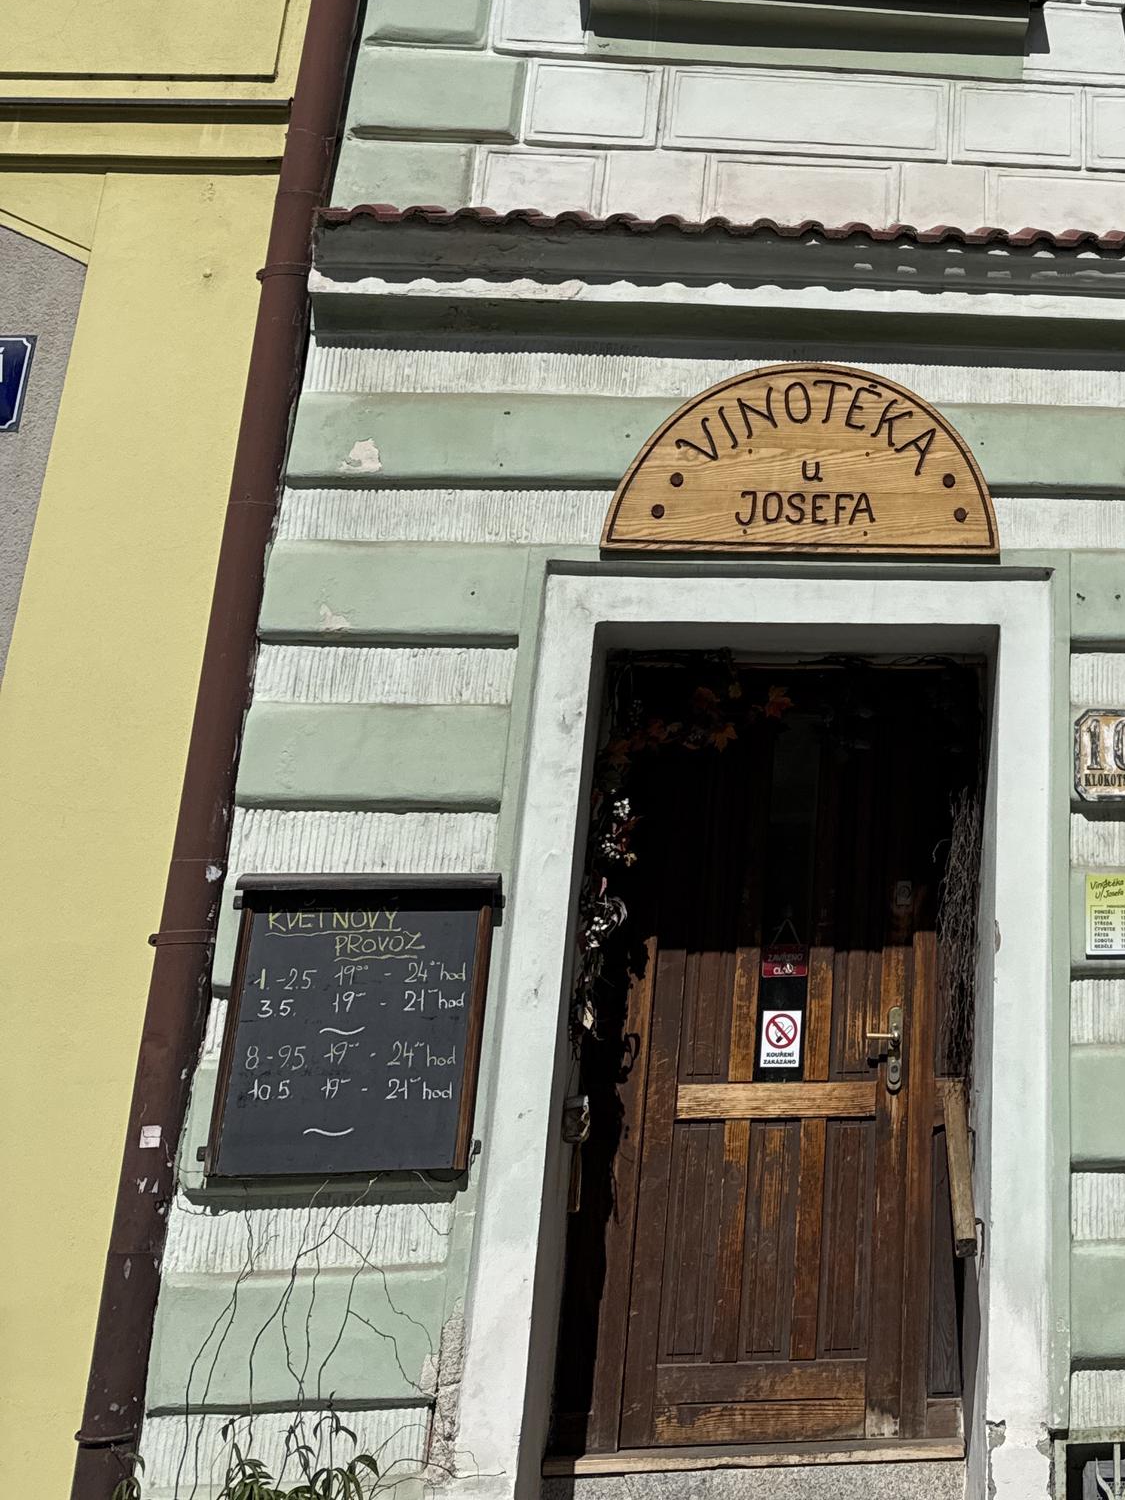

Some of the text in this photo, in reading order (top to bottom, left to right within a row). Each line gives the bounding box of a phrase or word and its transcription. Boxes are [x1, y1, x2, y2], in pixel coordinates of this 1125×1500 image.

[801, 459, 824, 483] u
[735, 490, 877, 526] JOSEFA
[334, 931, 426, 957] PROVOZ
[440, 961, 467, 982] hod
[439, 991, 466, 1010] hod
[427, 1045, 457, 1068] hod
[423, 1080, 454, 1101] hod
